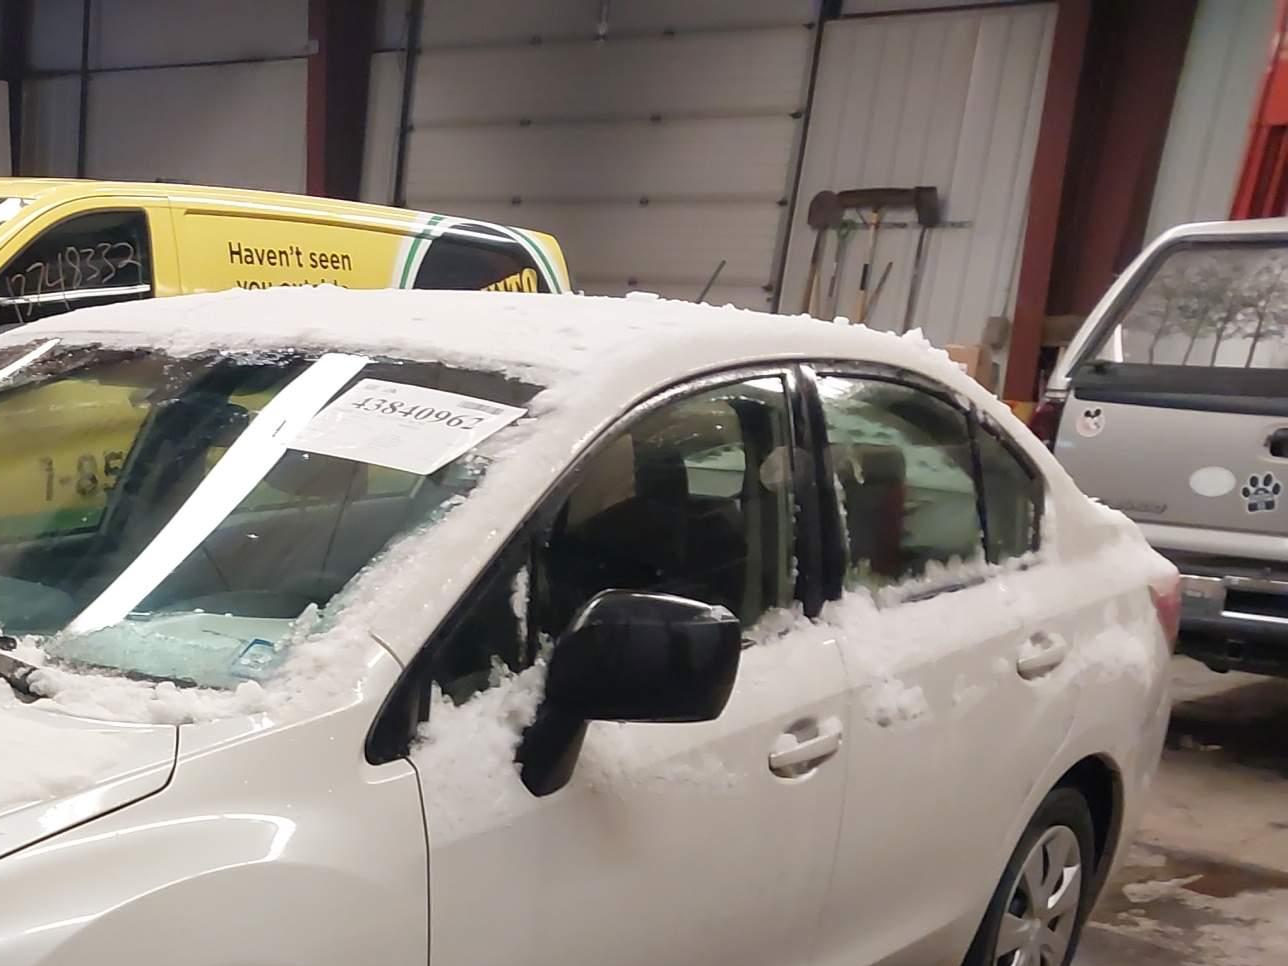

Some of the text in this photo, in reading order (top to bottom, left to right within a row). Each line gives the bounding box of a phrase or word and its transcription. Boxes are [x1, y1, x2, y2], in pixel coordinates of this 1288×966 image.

[228, 241, 352, 271] Haven't seen
[352, 397, 484, 430] 43840962
